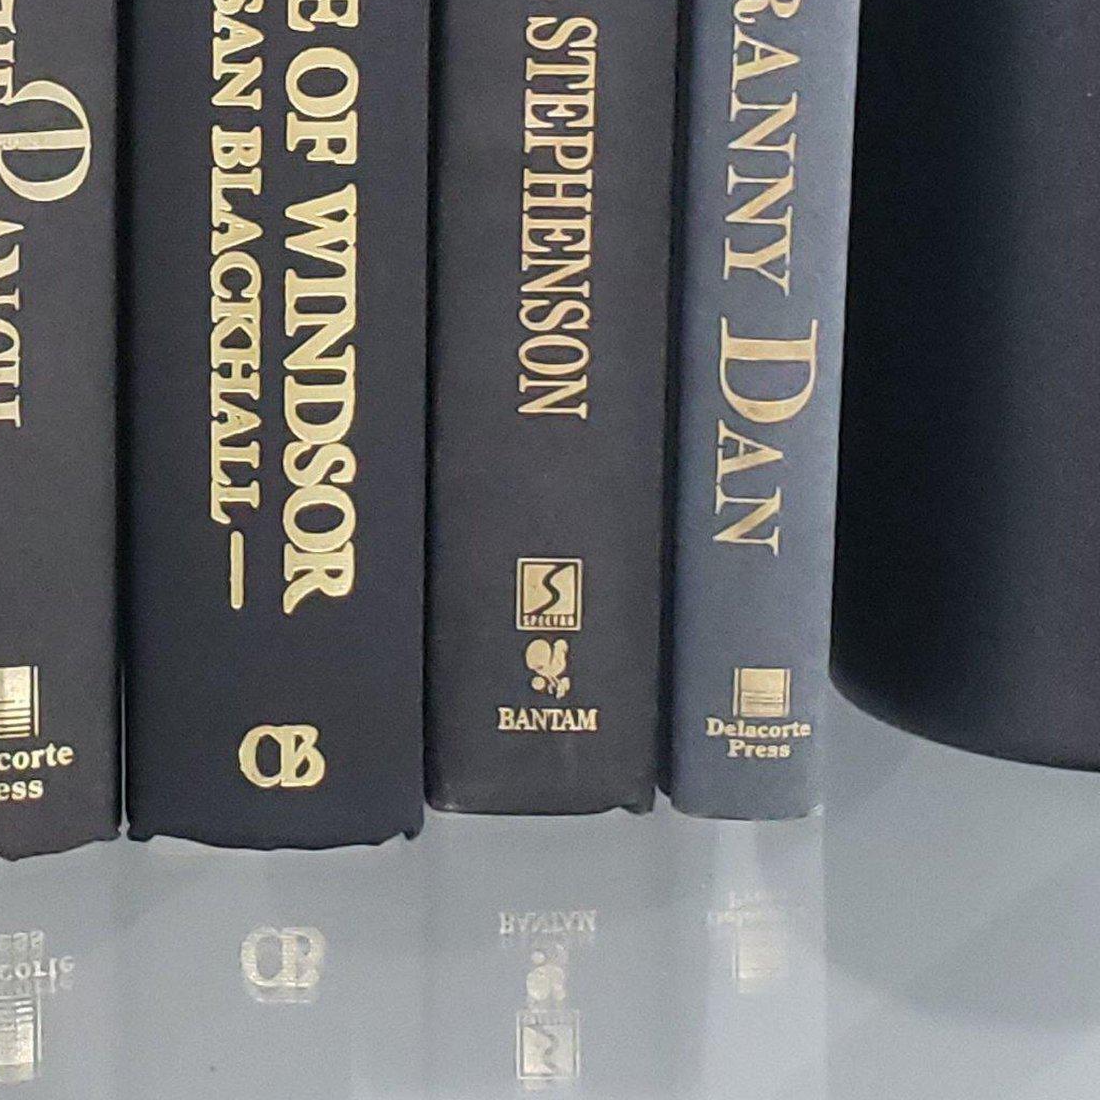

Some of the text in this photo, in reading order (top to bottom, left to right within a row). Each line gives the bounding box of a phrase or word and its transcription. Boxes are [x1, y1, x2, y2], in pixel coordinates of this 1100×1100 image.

[285, 46, 359, 165] OF
[517, 16, 598, 420] STEPHENSON
[209, 124, 264, 525] BLACKHALL
[282, 183, 357, 614] WINDSOR
[712, 316, 819, 557] DAN
[497, 706, 598, 732] BANTAM
[706, 717, 812, 740] Delacorte
[727, 738, 791, 759] Press
